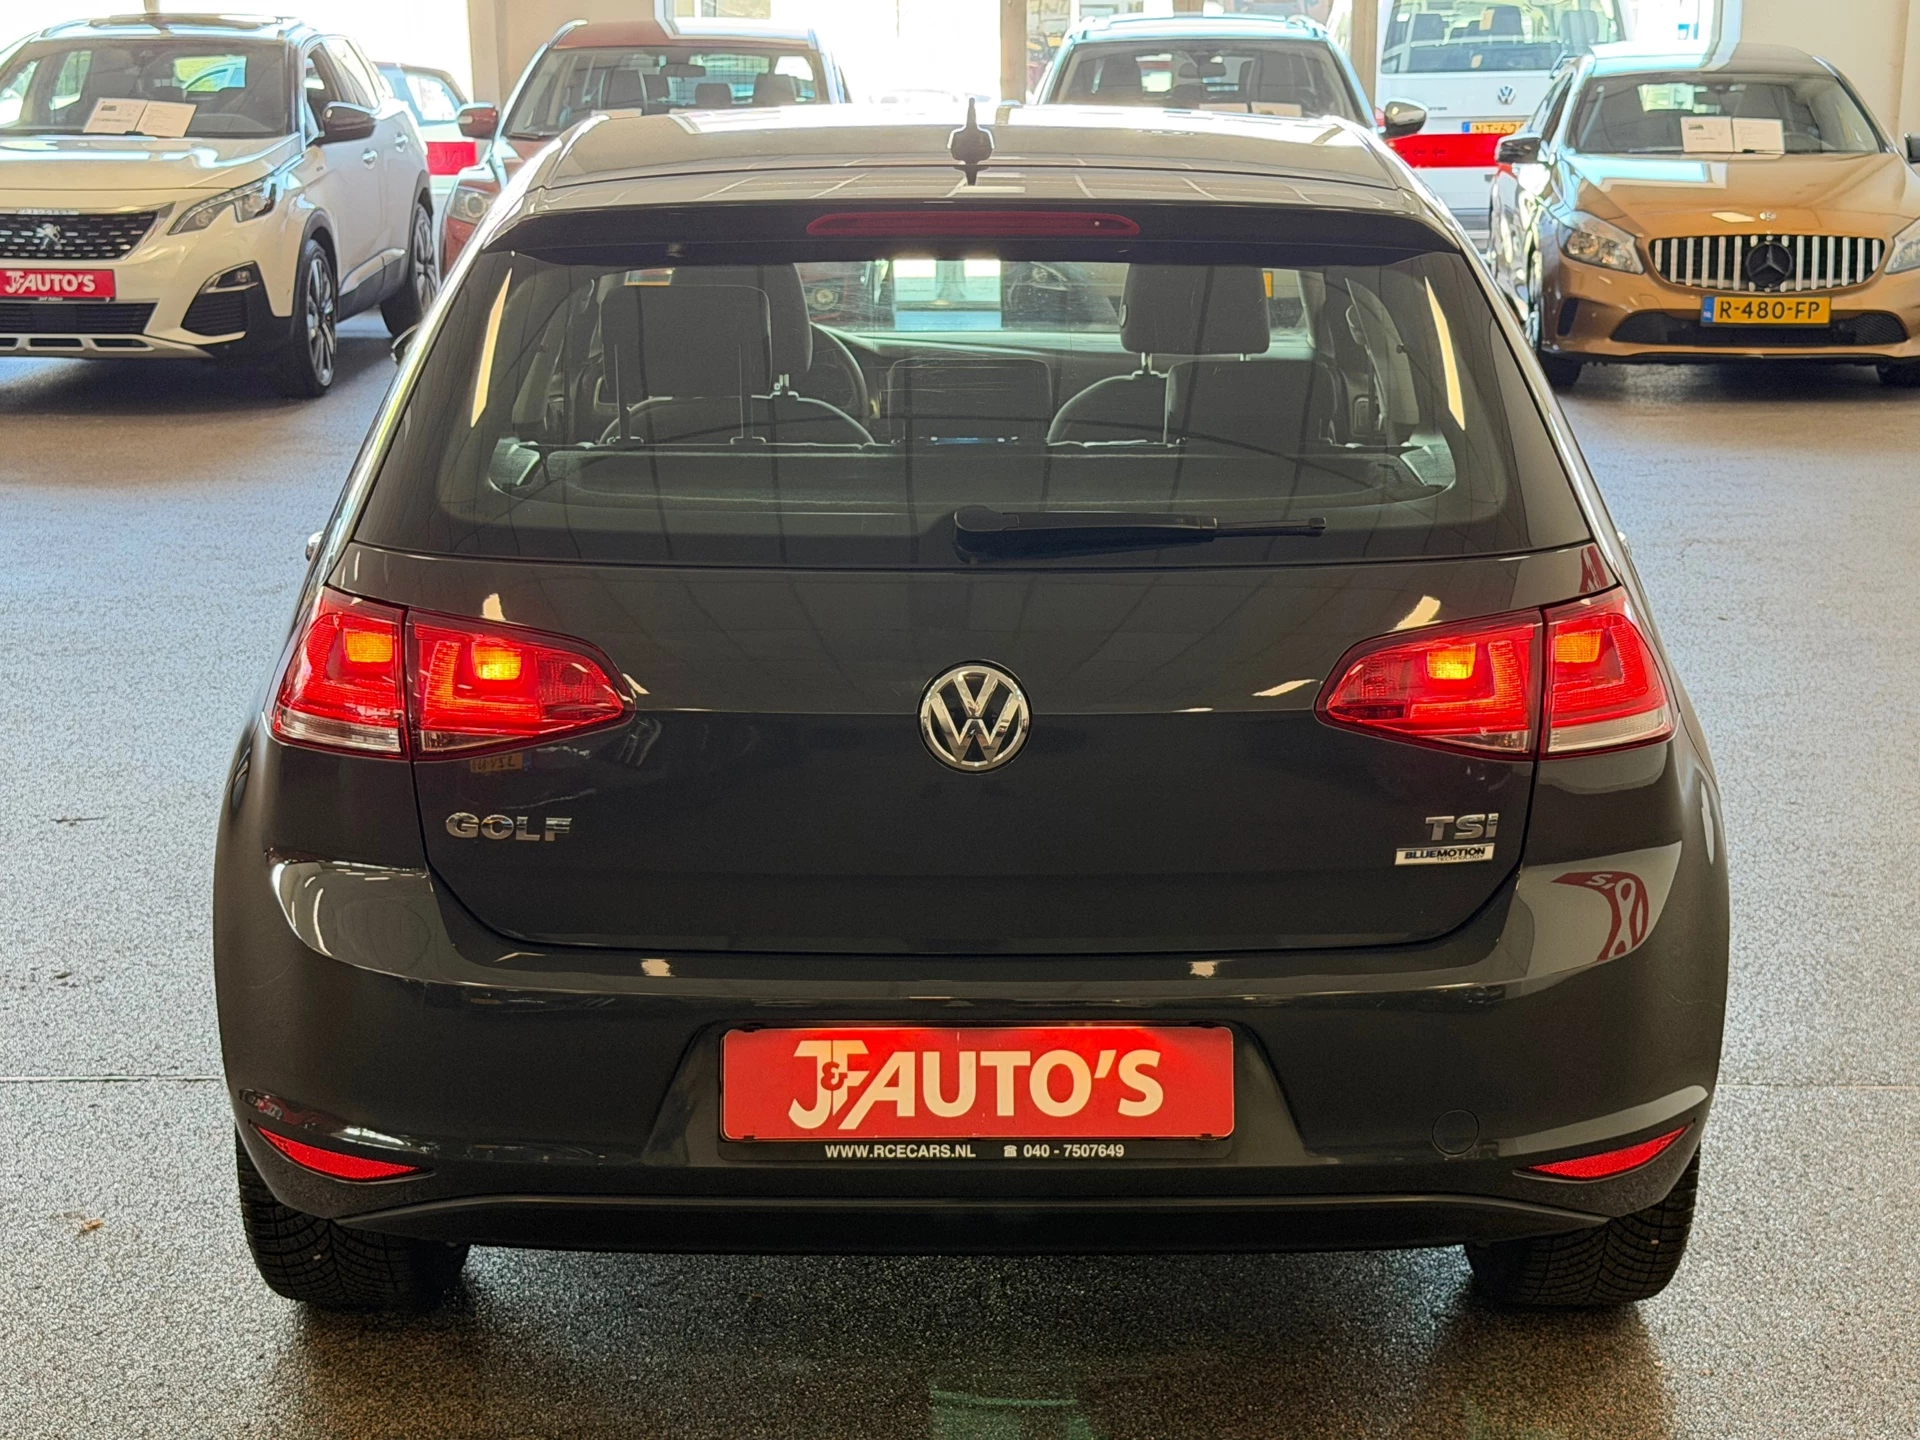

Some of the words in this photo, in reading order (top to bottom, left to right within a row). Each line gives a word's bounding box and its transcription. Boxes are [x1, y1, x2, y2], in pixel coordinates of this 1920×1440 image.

[18, 273, 96, 293] AUTO'S
[1719, 300, 1821, 320] R-480-FP
[919, 662, 1031, 773] VW
[445, 811, 573, 842] GOLF
[1404, 847, 1486, 860] BLUEMOTION
[838, 1049, 1164, 1130] AUTO'S
[825, 1144, 976, 1158] WWW.RCECARS.NL
[1023, 1144, 1050, 1158] 040
[1063, 1144, 1125, 1158] 7507649
